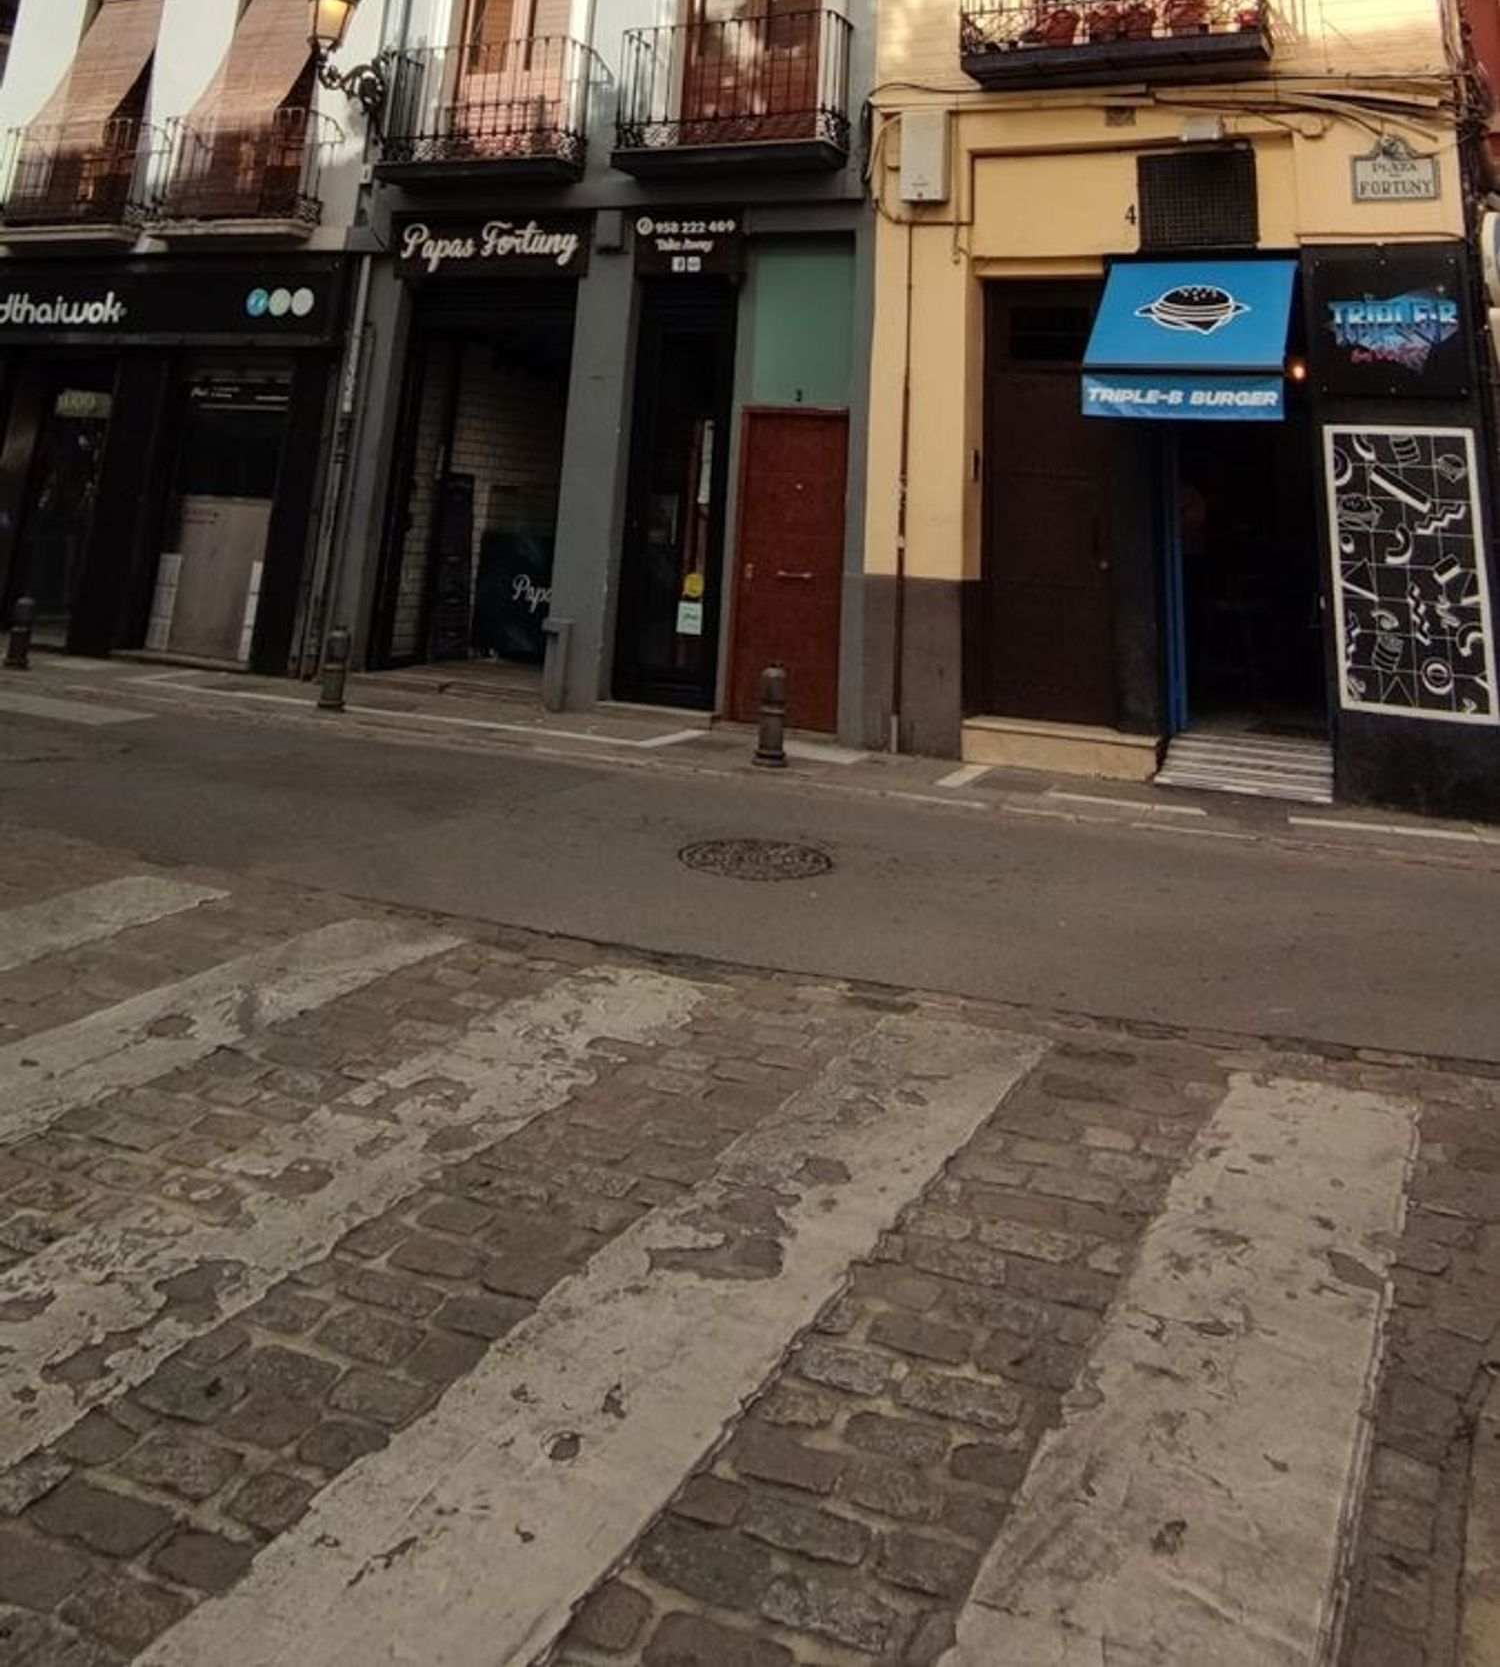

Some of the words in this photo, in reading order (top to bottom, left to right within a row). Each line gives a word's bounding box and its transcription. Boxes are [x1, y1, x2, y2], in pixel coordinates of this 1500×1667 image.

[1360, 180, 1432, 195] FORTUNY
[1124, 203, 1137, 226] 4
[681, 220, 706, 234] 222
[400, 222, 477, 273] Papas
[480, 220, 579, 266] Fortuny
[655, 237, 681, 251] Take
[1087, 387, 1184, 405] TRIPLE-B
[1189, 389, 1279, 407] BURGER
